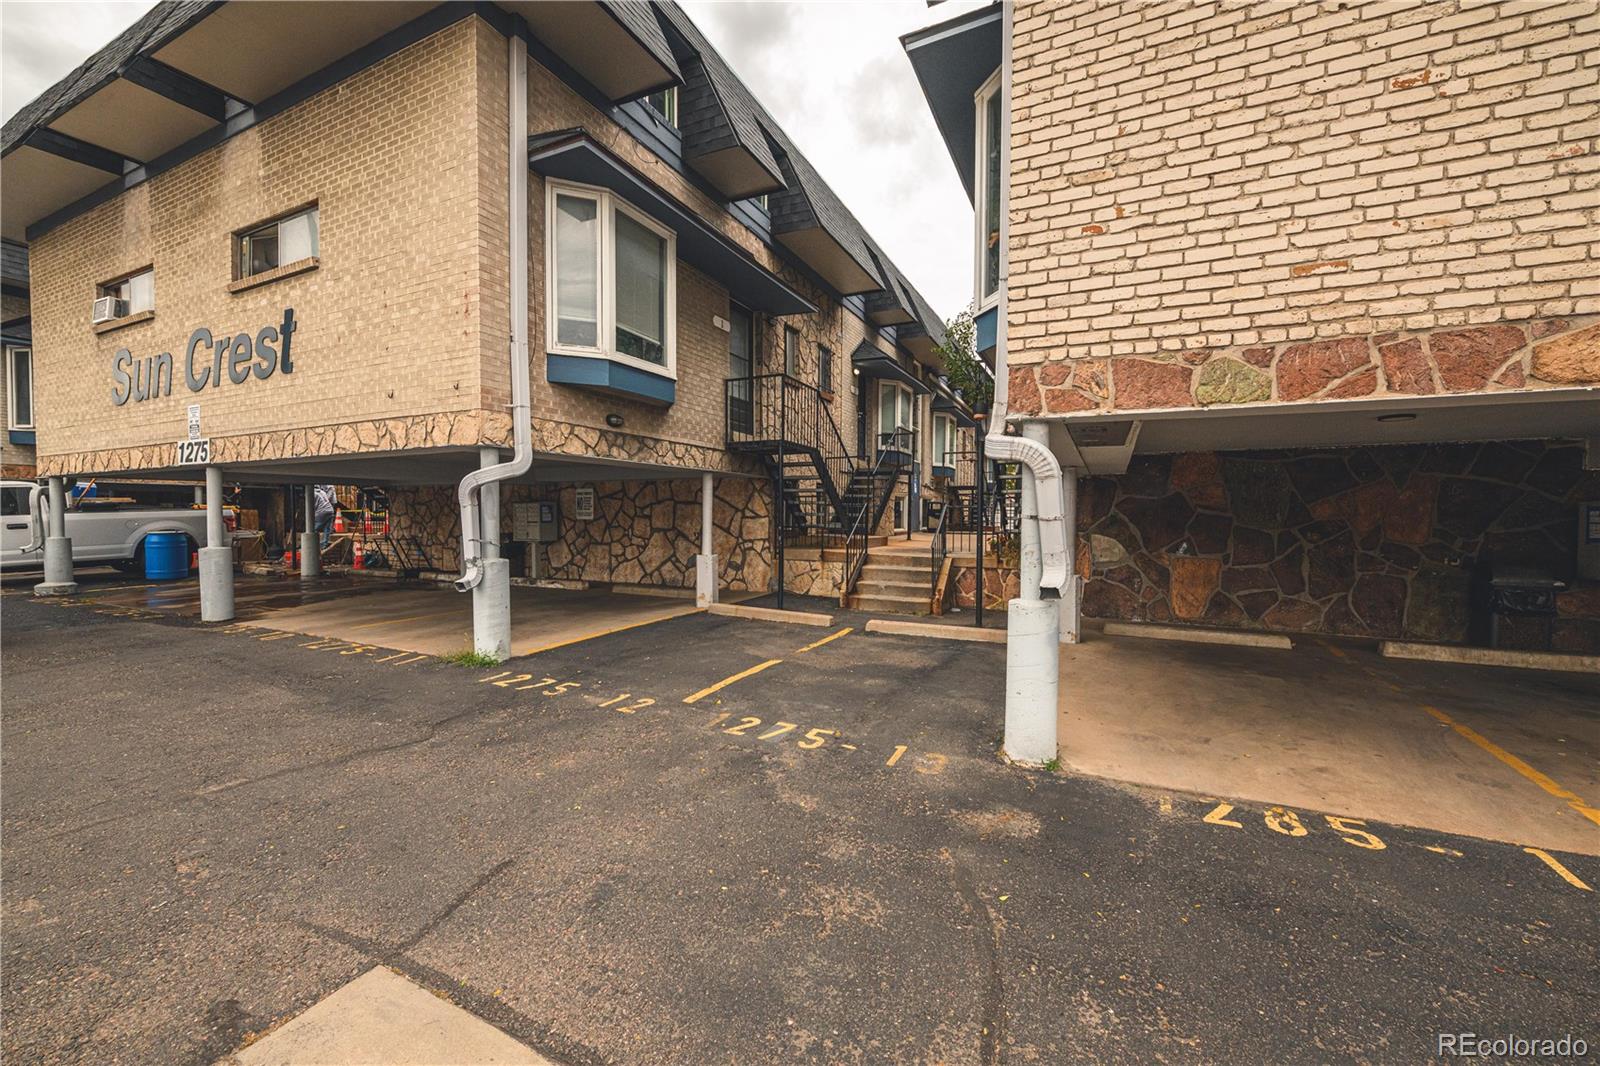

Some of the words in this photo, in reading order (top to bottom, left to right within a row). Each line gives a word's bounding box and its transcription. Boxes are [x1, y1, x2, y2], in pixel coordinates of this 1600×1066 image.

[111, 348, 173, 406] Sun
[185, 308, 297, 392] Crest
[178, 441, 208, 463] 1275
